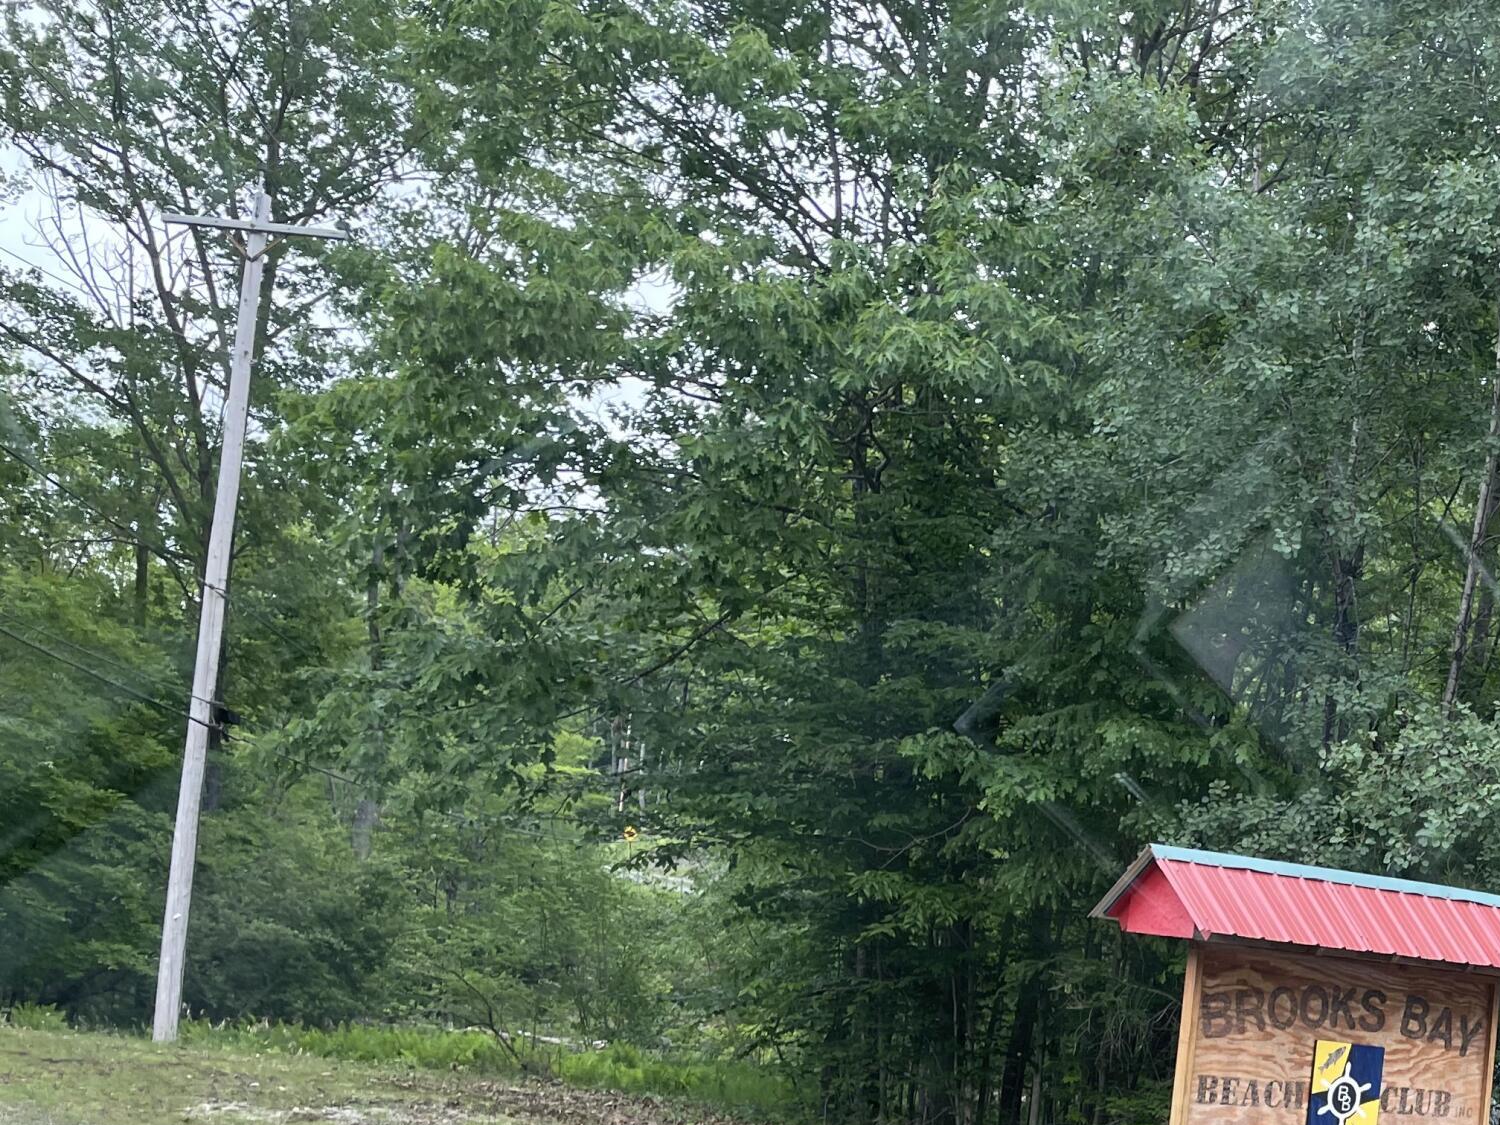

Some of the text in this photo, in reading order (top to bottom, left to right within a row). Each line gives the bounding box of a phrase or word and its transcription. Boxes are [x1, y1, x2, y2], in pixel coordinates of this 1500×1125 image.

[1200, 985, 1483, 1057] BROOKS BAY
[1196, 1074, 1305, 1109] BEACH
[1381, 1085, 1452, 1117] CLUB
